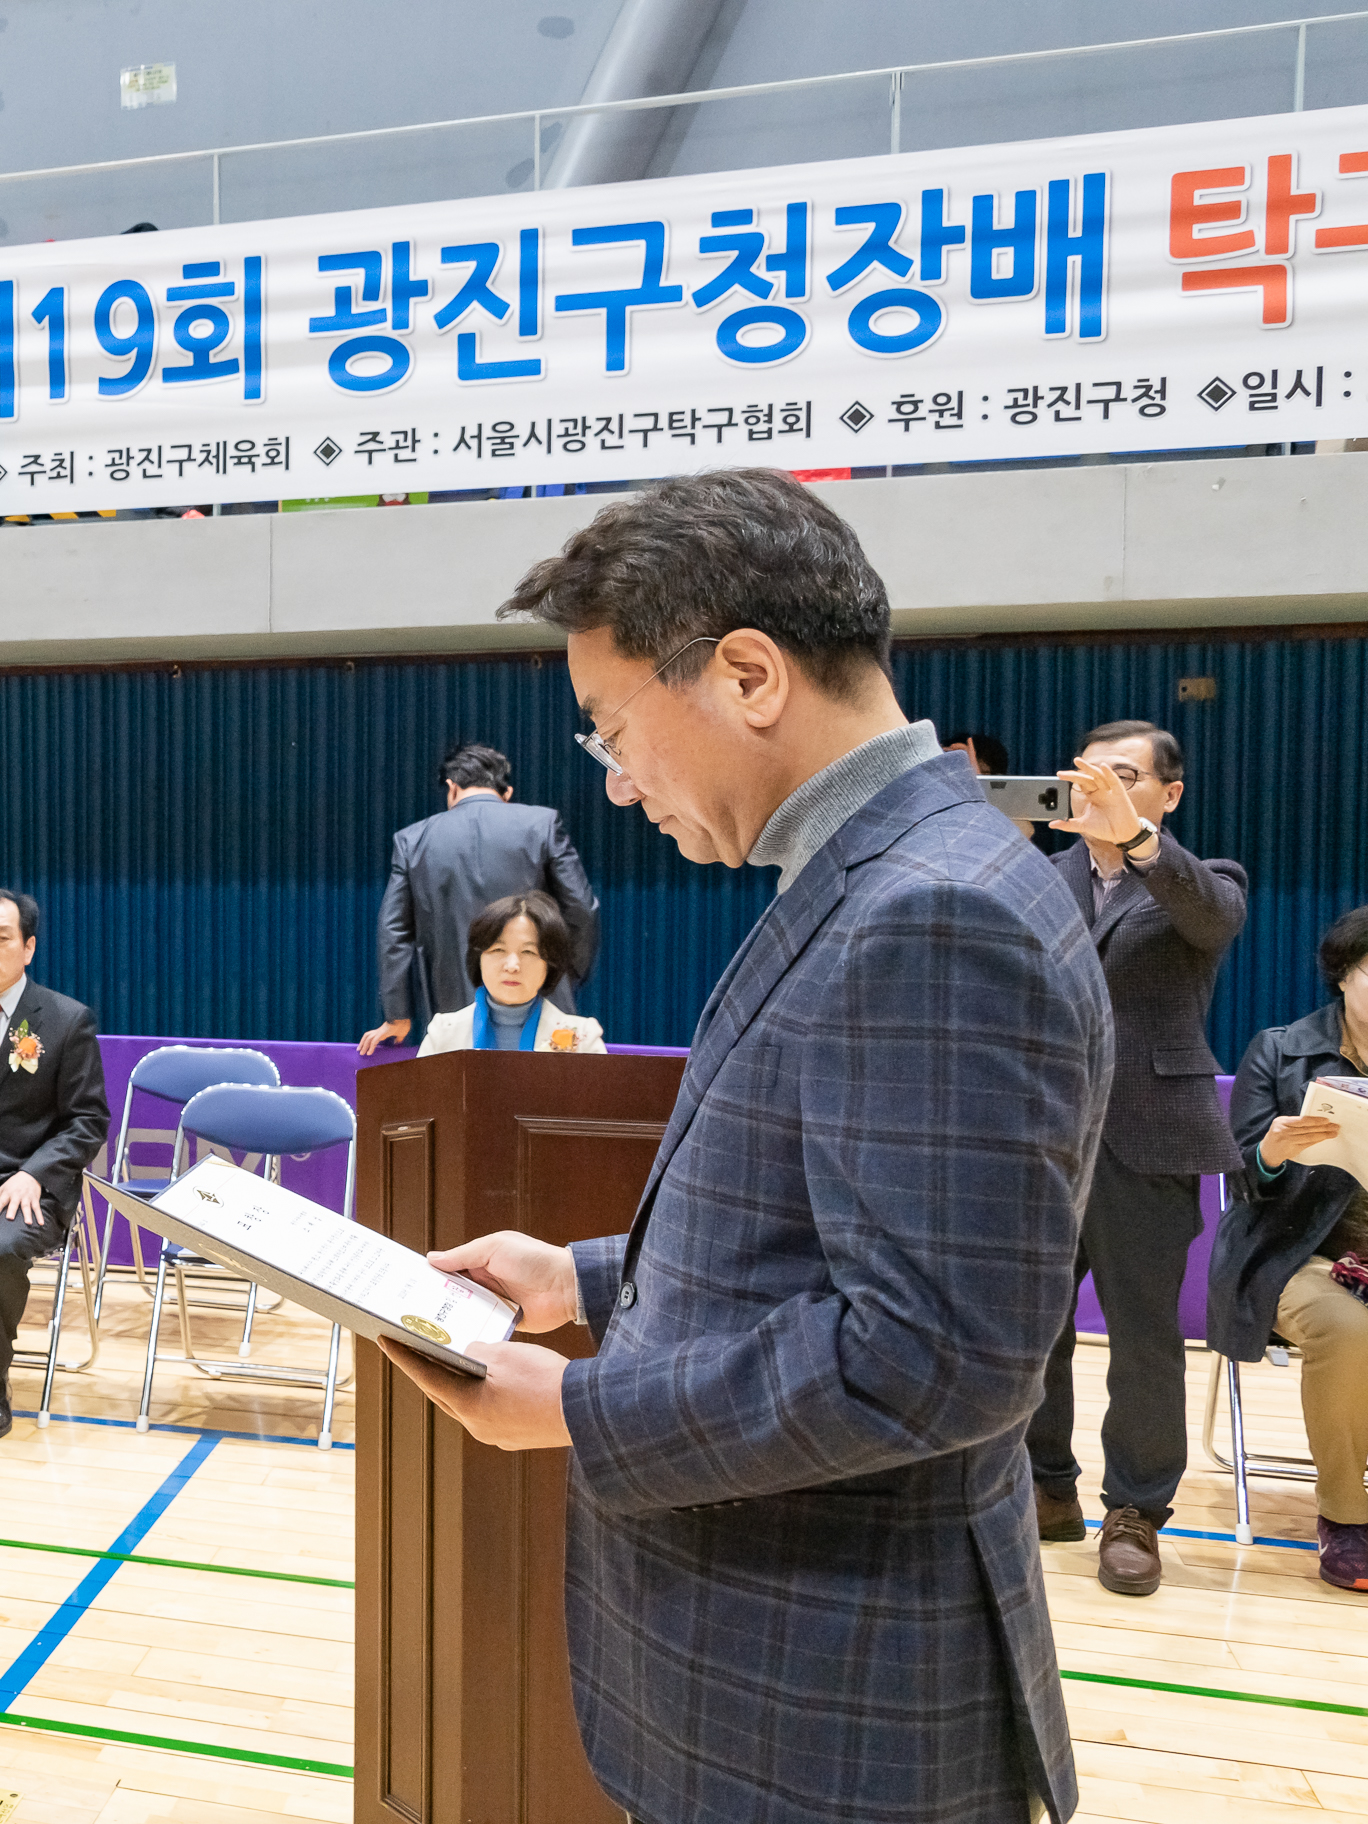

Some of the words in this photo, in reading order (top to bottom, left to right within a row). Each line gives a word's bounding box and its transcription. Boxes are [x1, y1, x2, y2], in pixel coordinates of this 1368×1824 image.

[309, 172, 1107, 393] 광진구청장배
[888, 390, 965, 432] 후원
[1004, 376, 1167, 425] 광진구청
[1242, 366, 1323, 411] 일시
[18, 452, 75, 486] 주최
[105, 436, 290, 482] 광진구체육회
[354, 427, 421, 466] 주관
[452, 400, 812, 458] 서울시광진구탁구협회
